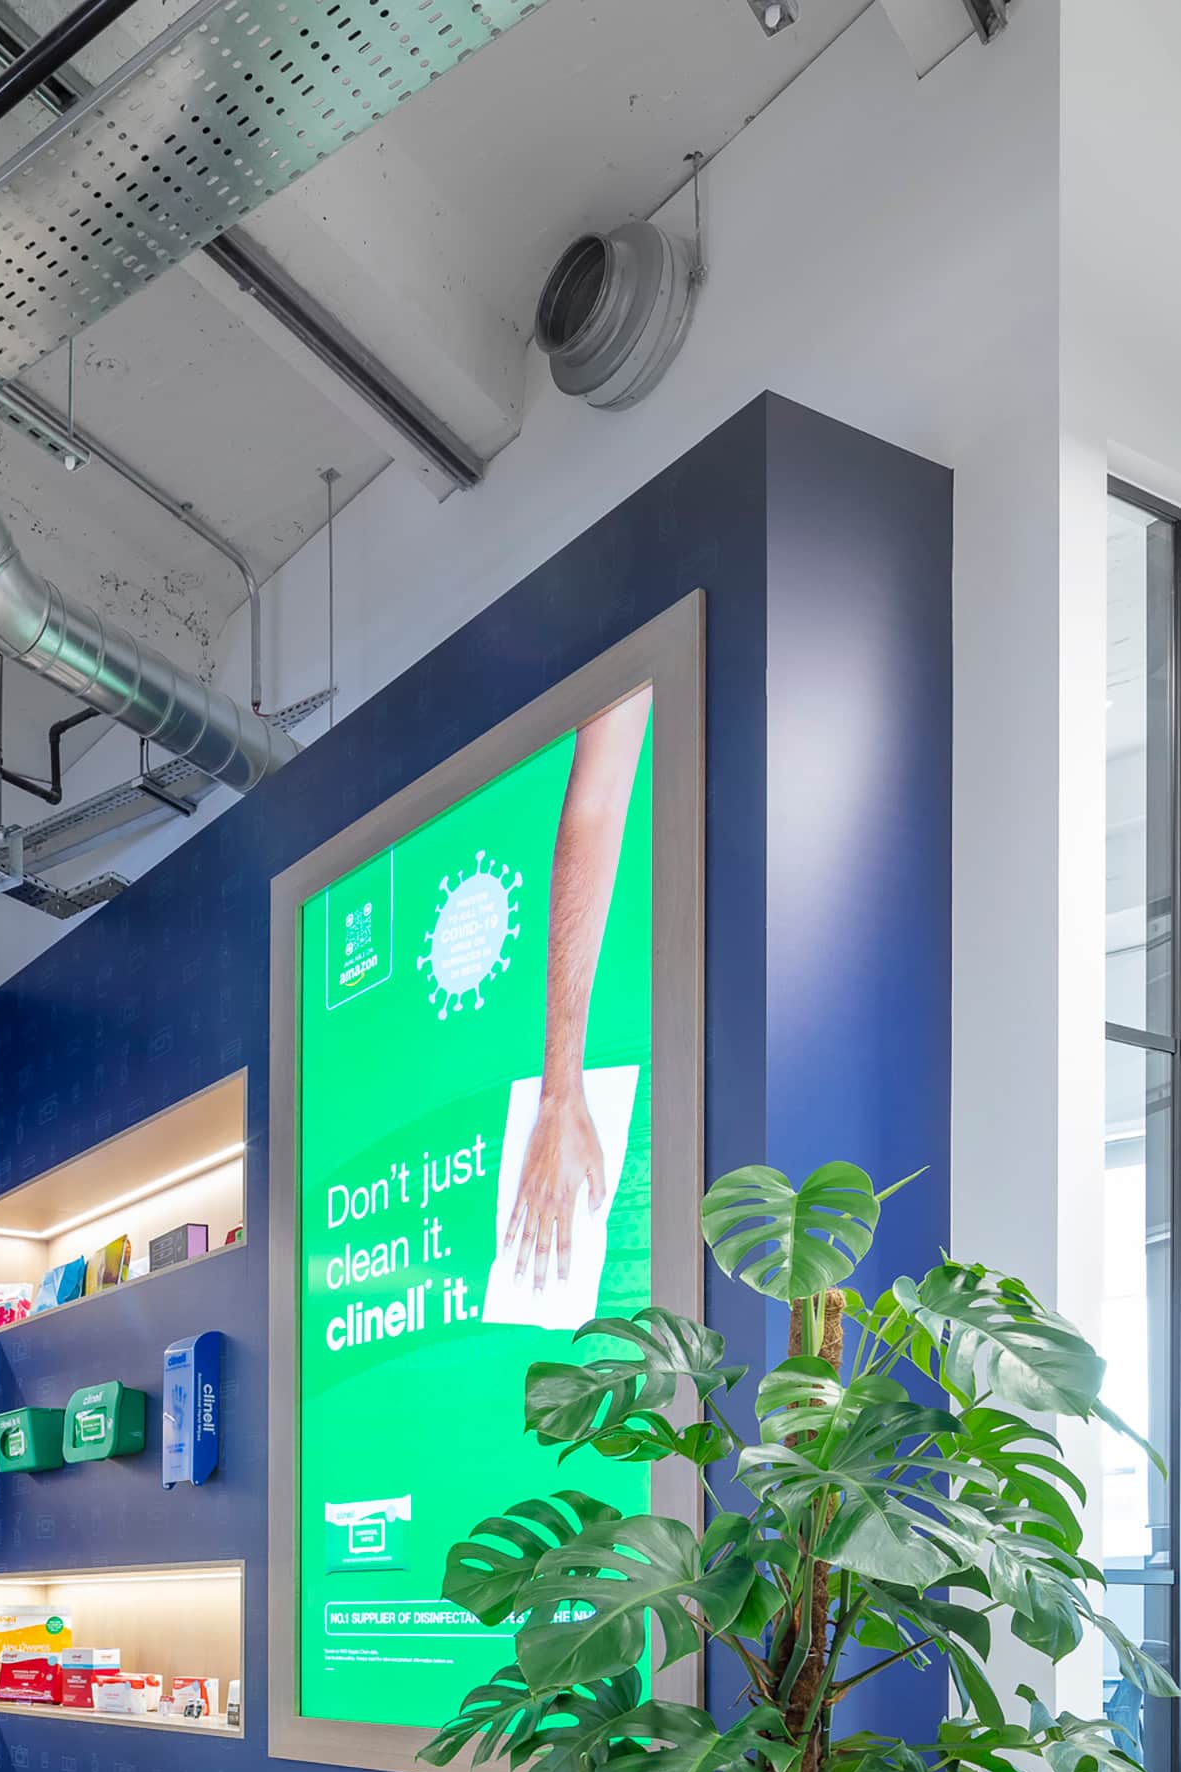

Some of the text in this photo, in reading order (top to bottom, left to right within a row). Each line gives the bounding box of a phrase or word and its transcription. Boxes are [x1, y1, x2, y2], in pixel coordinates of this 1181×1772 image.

[339, 953, 378, 985] amazon
[327, 1134, 486, 1229] Don't just
[326, 1218, 451, 1290] clean it.
[326, 1277, 479, 1351] clinell it.
[202, 1383, 216, 1435] clinell
[330, 1612, 349, 1624] NO.1
[351, 1611, 396, 1624] SUPPLIER
[398, 1611, 412, 1624] OF
[413, 1610, 481, 1625] DISINFECTAN
